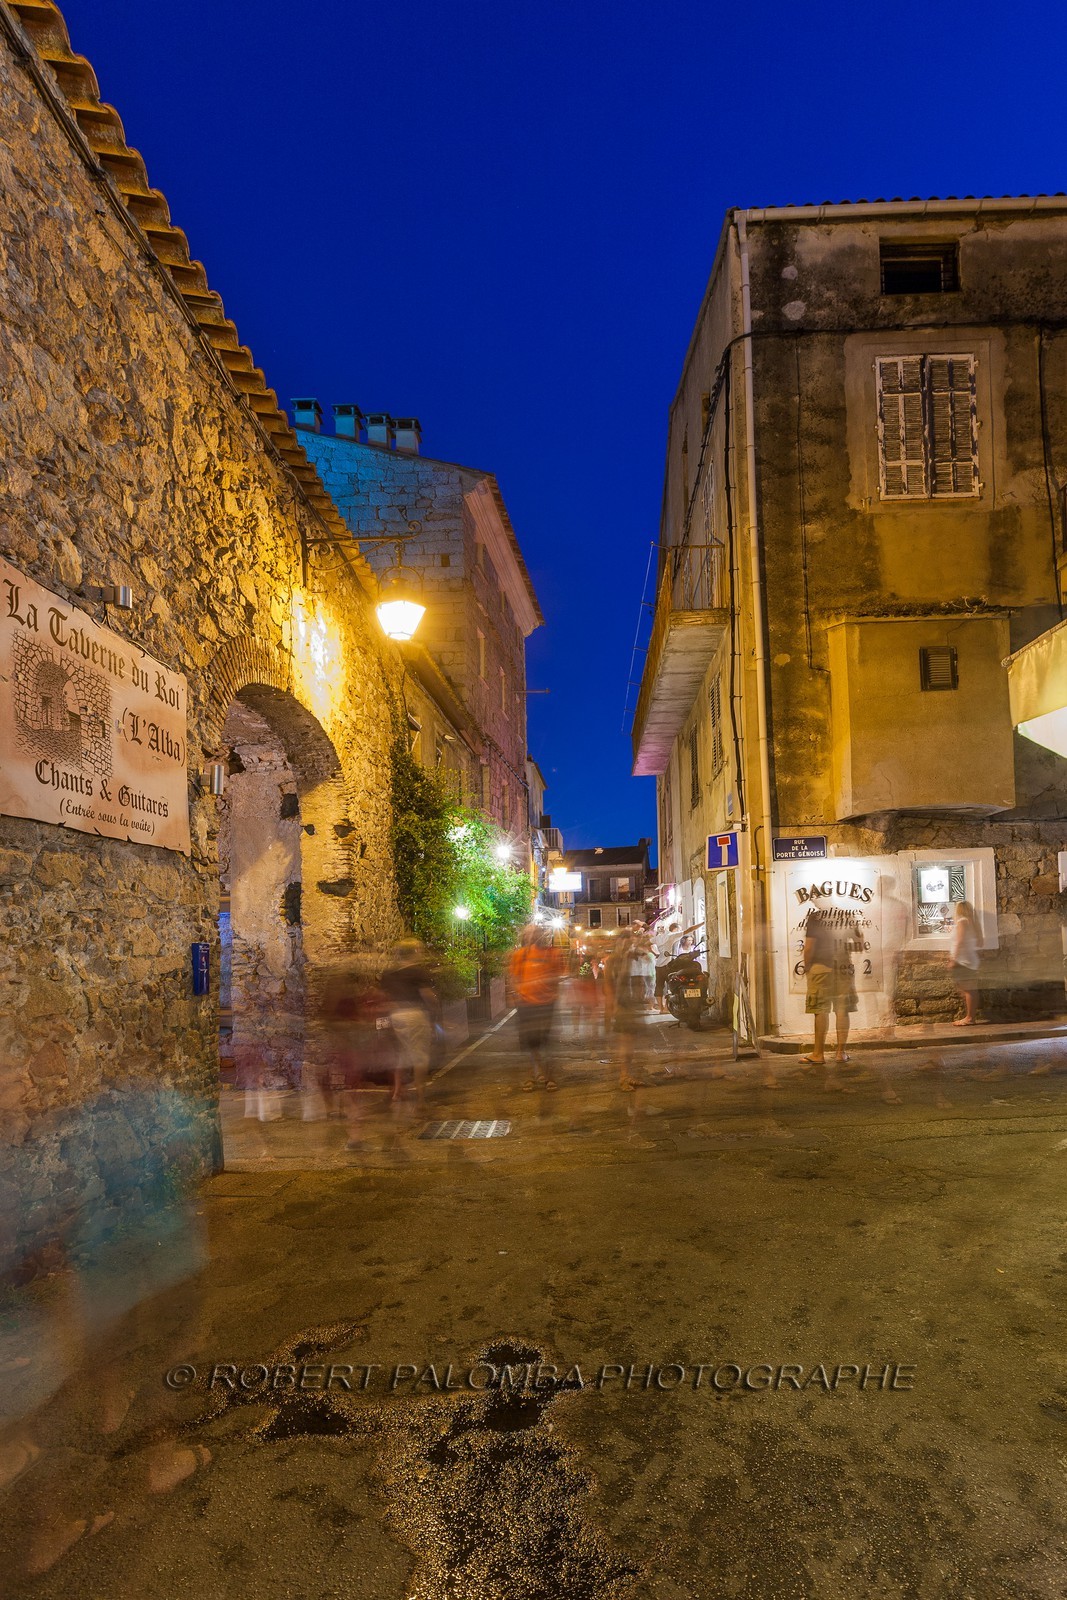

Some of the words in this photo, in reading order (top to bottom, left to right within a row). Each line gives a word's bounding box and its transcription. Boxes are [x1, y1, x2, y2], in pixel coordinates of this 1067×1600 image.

[3, 579, 39, 632] La
[48, 607, 126, 679] Taverne
[132, 658, 150, 693] du
[154, 670, 180, 710] Roi
[35, 759, 93, 796] Chants
[99, 778, 112, 802] &
[118, 785, 169, 818] Guitares
[60, 798, 95, 820] (Entrée
[97, 812, 117, 824] sous
[119, 813, 129, 827] la
[131, 821, 155, 836] voûte)
[796, 880, 874, 905] BAGUES
[794, 960, 806, 976] 6
[862, 959, 873, 975] 2
